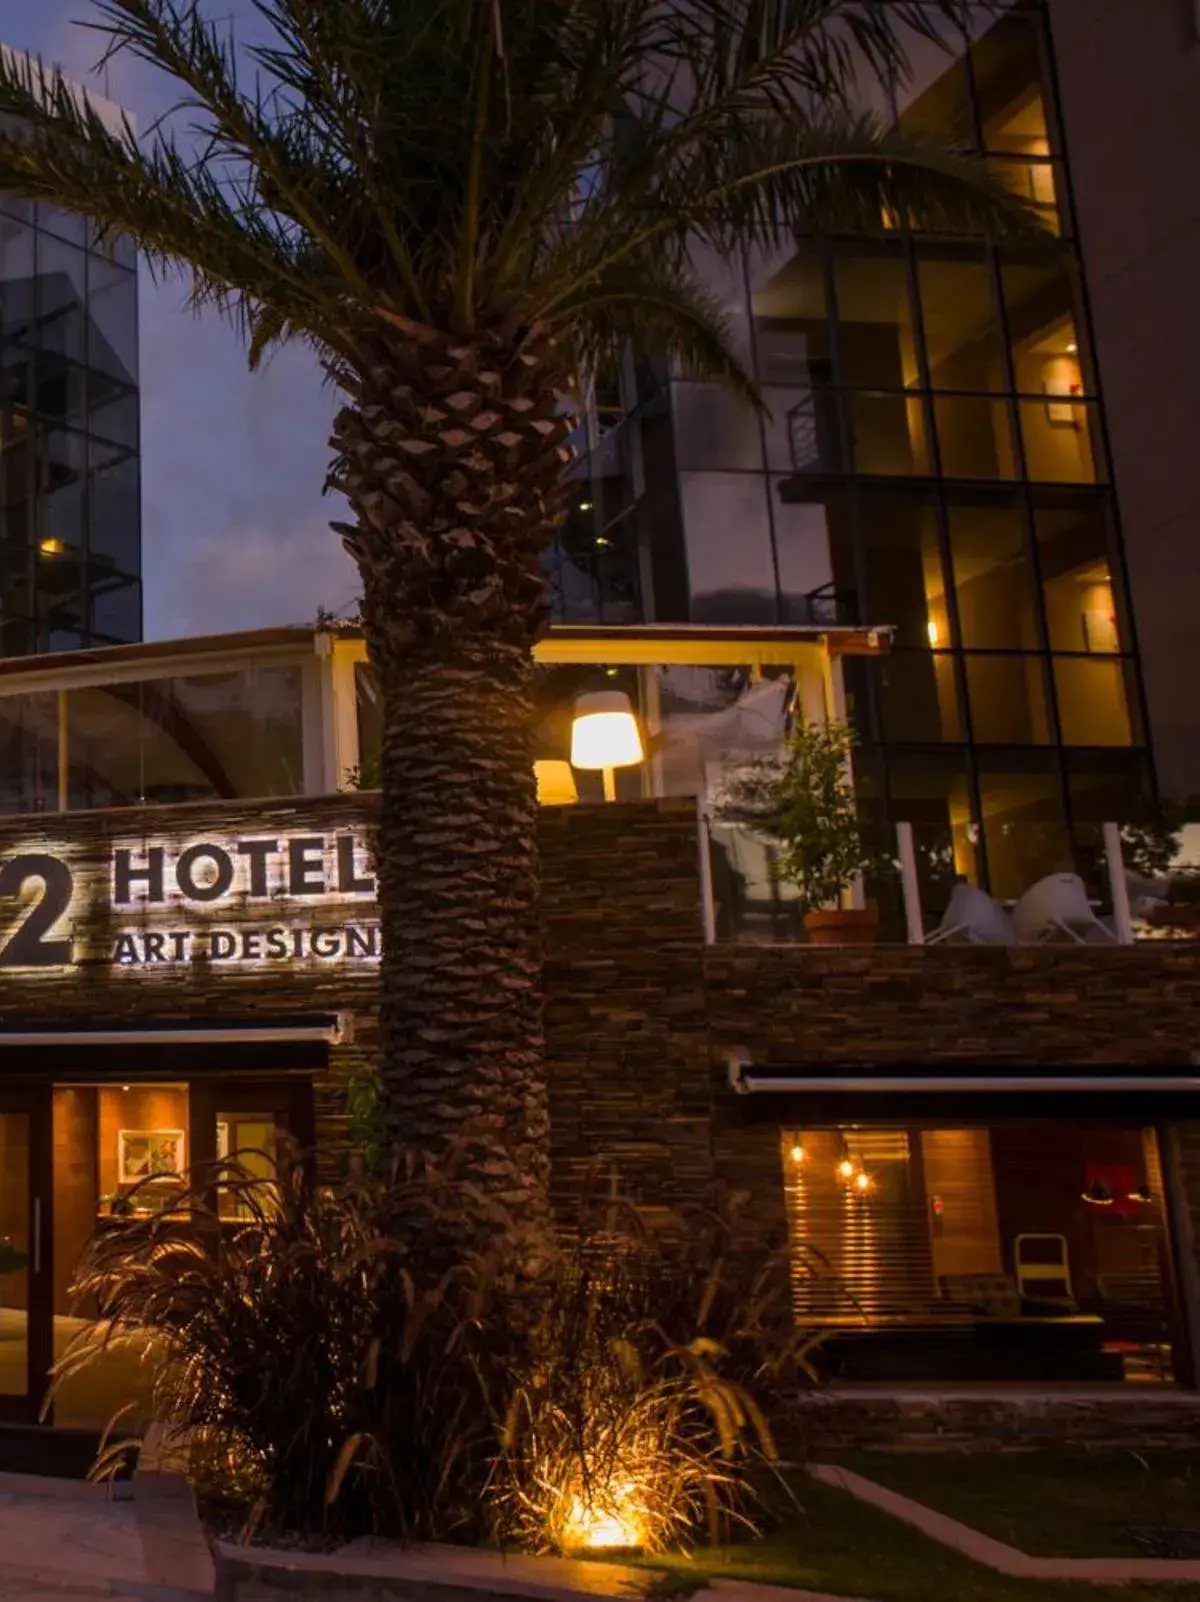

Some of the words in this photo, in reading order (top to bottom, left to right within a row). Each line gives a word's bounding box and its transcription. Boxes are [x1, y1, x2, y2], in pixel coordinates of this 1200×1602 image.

[114, 836, 375, 903] HOTEL
[114, 931, 190, 964] ART
[211, 927, 377, 959] DESIGN
